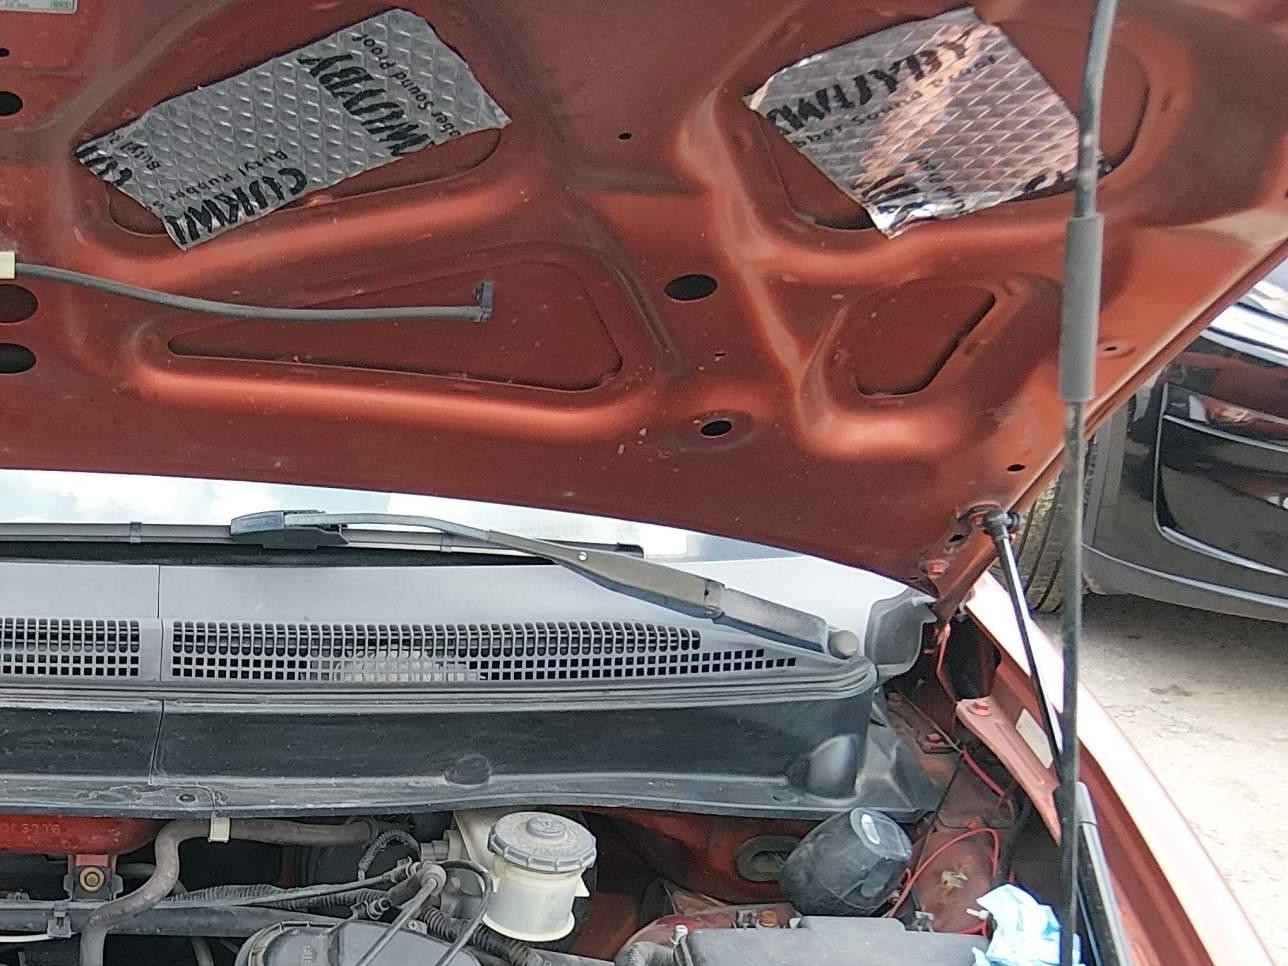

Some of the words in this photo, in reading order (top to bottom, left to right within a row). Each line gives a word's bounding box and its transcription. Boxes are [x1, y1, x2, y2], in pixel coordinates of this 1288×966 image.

[352, 34, 396, 70] Proof
[391, 72, 434, 110] Sound
[239, 149, 289, 176] Butyl
[168, 173, 234, 201] Rubber
